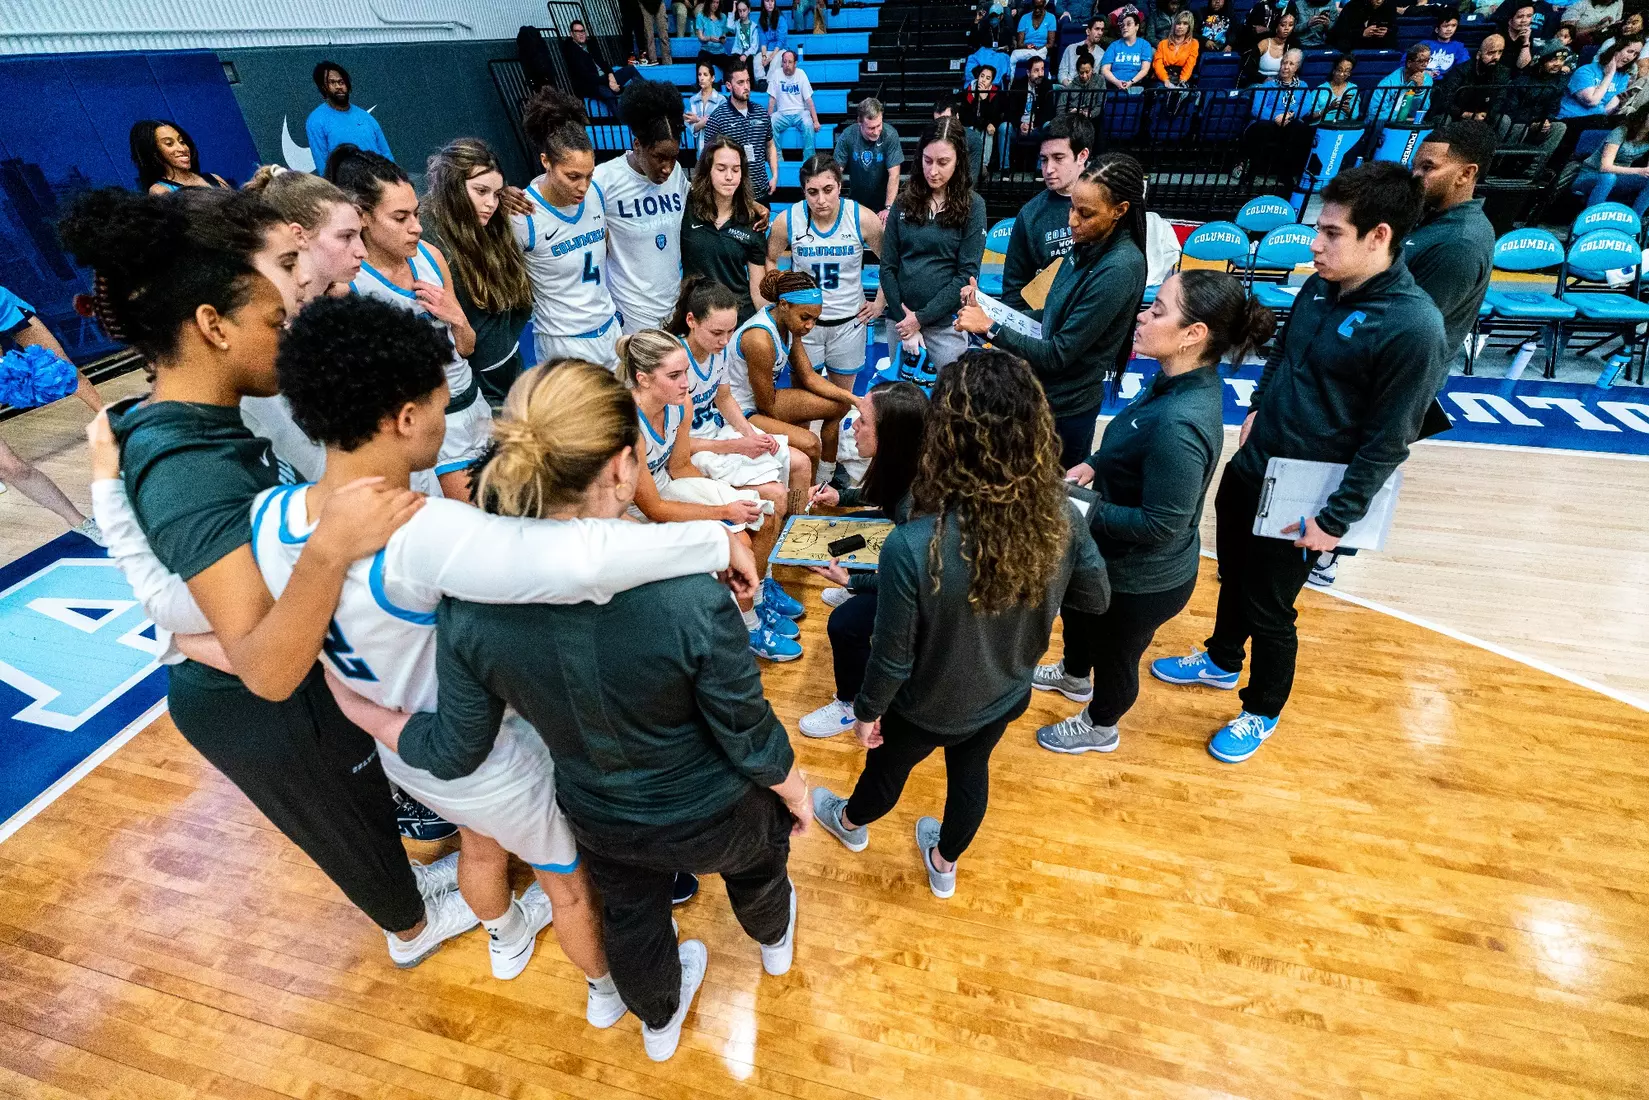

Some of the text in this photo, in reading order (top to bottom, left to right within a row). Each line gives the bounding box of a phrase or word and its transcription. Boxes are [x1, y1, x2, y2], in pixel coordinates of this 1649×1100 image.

[1325, 133, 1345, 176] POWERADE
[617, 193, 682, 218] LIONS
[1246, 204, 1288, 216] COLUMBIA
[1585, 211, 1633, 224] COLUMBIA
[1194, 232, 1241, 245] COLUMBIA
[1500, 238, 1555, 252] COLUMBIA
[797, 245, 855, 257] COLUMBIA
[1580, 239, 1633, 253] COLUMBIA
[581, 250, 600, 286] 4
[811, 262, 840, 290] 15
